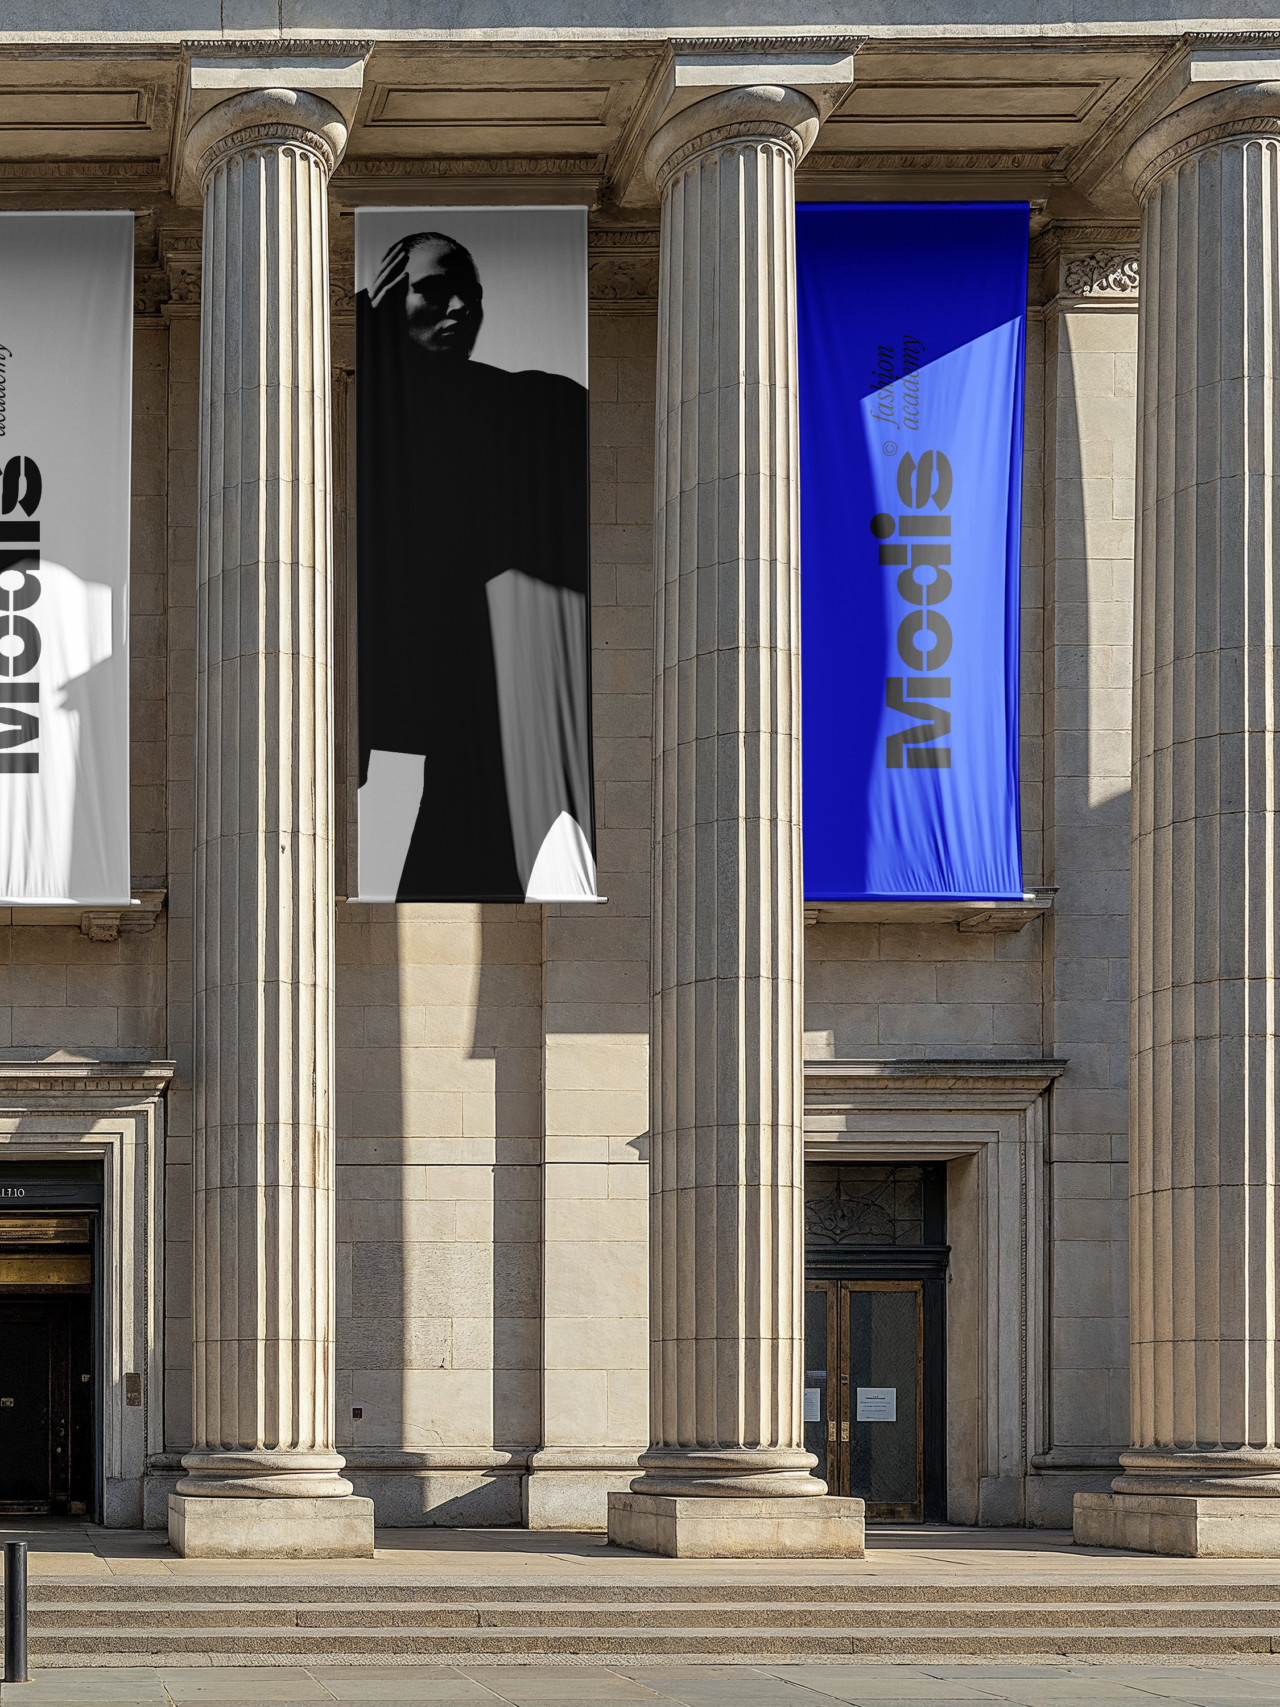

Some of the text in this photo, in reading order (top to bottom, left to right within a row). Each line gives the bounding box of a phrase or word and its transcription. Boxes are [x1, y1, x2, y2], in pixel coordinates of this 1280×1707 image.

[870, 345, 900, 430] fashion
[895, 335, 925, 430] academy
[870, 449, 953, 768] Modis
